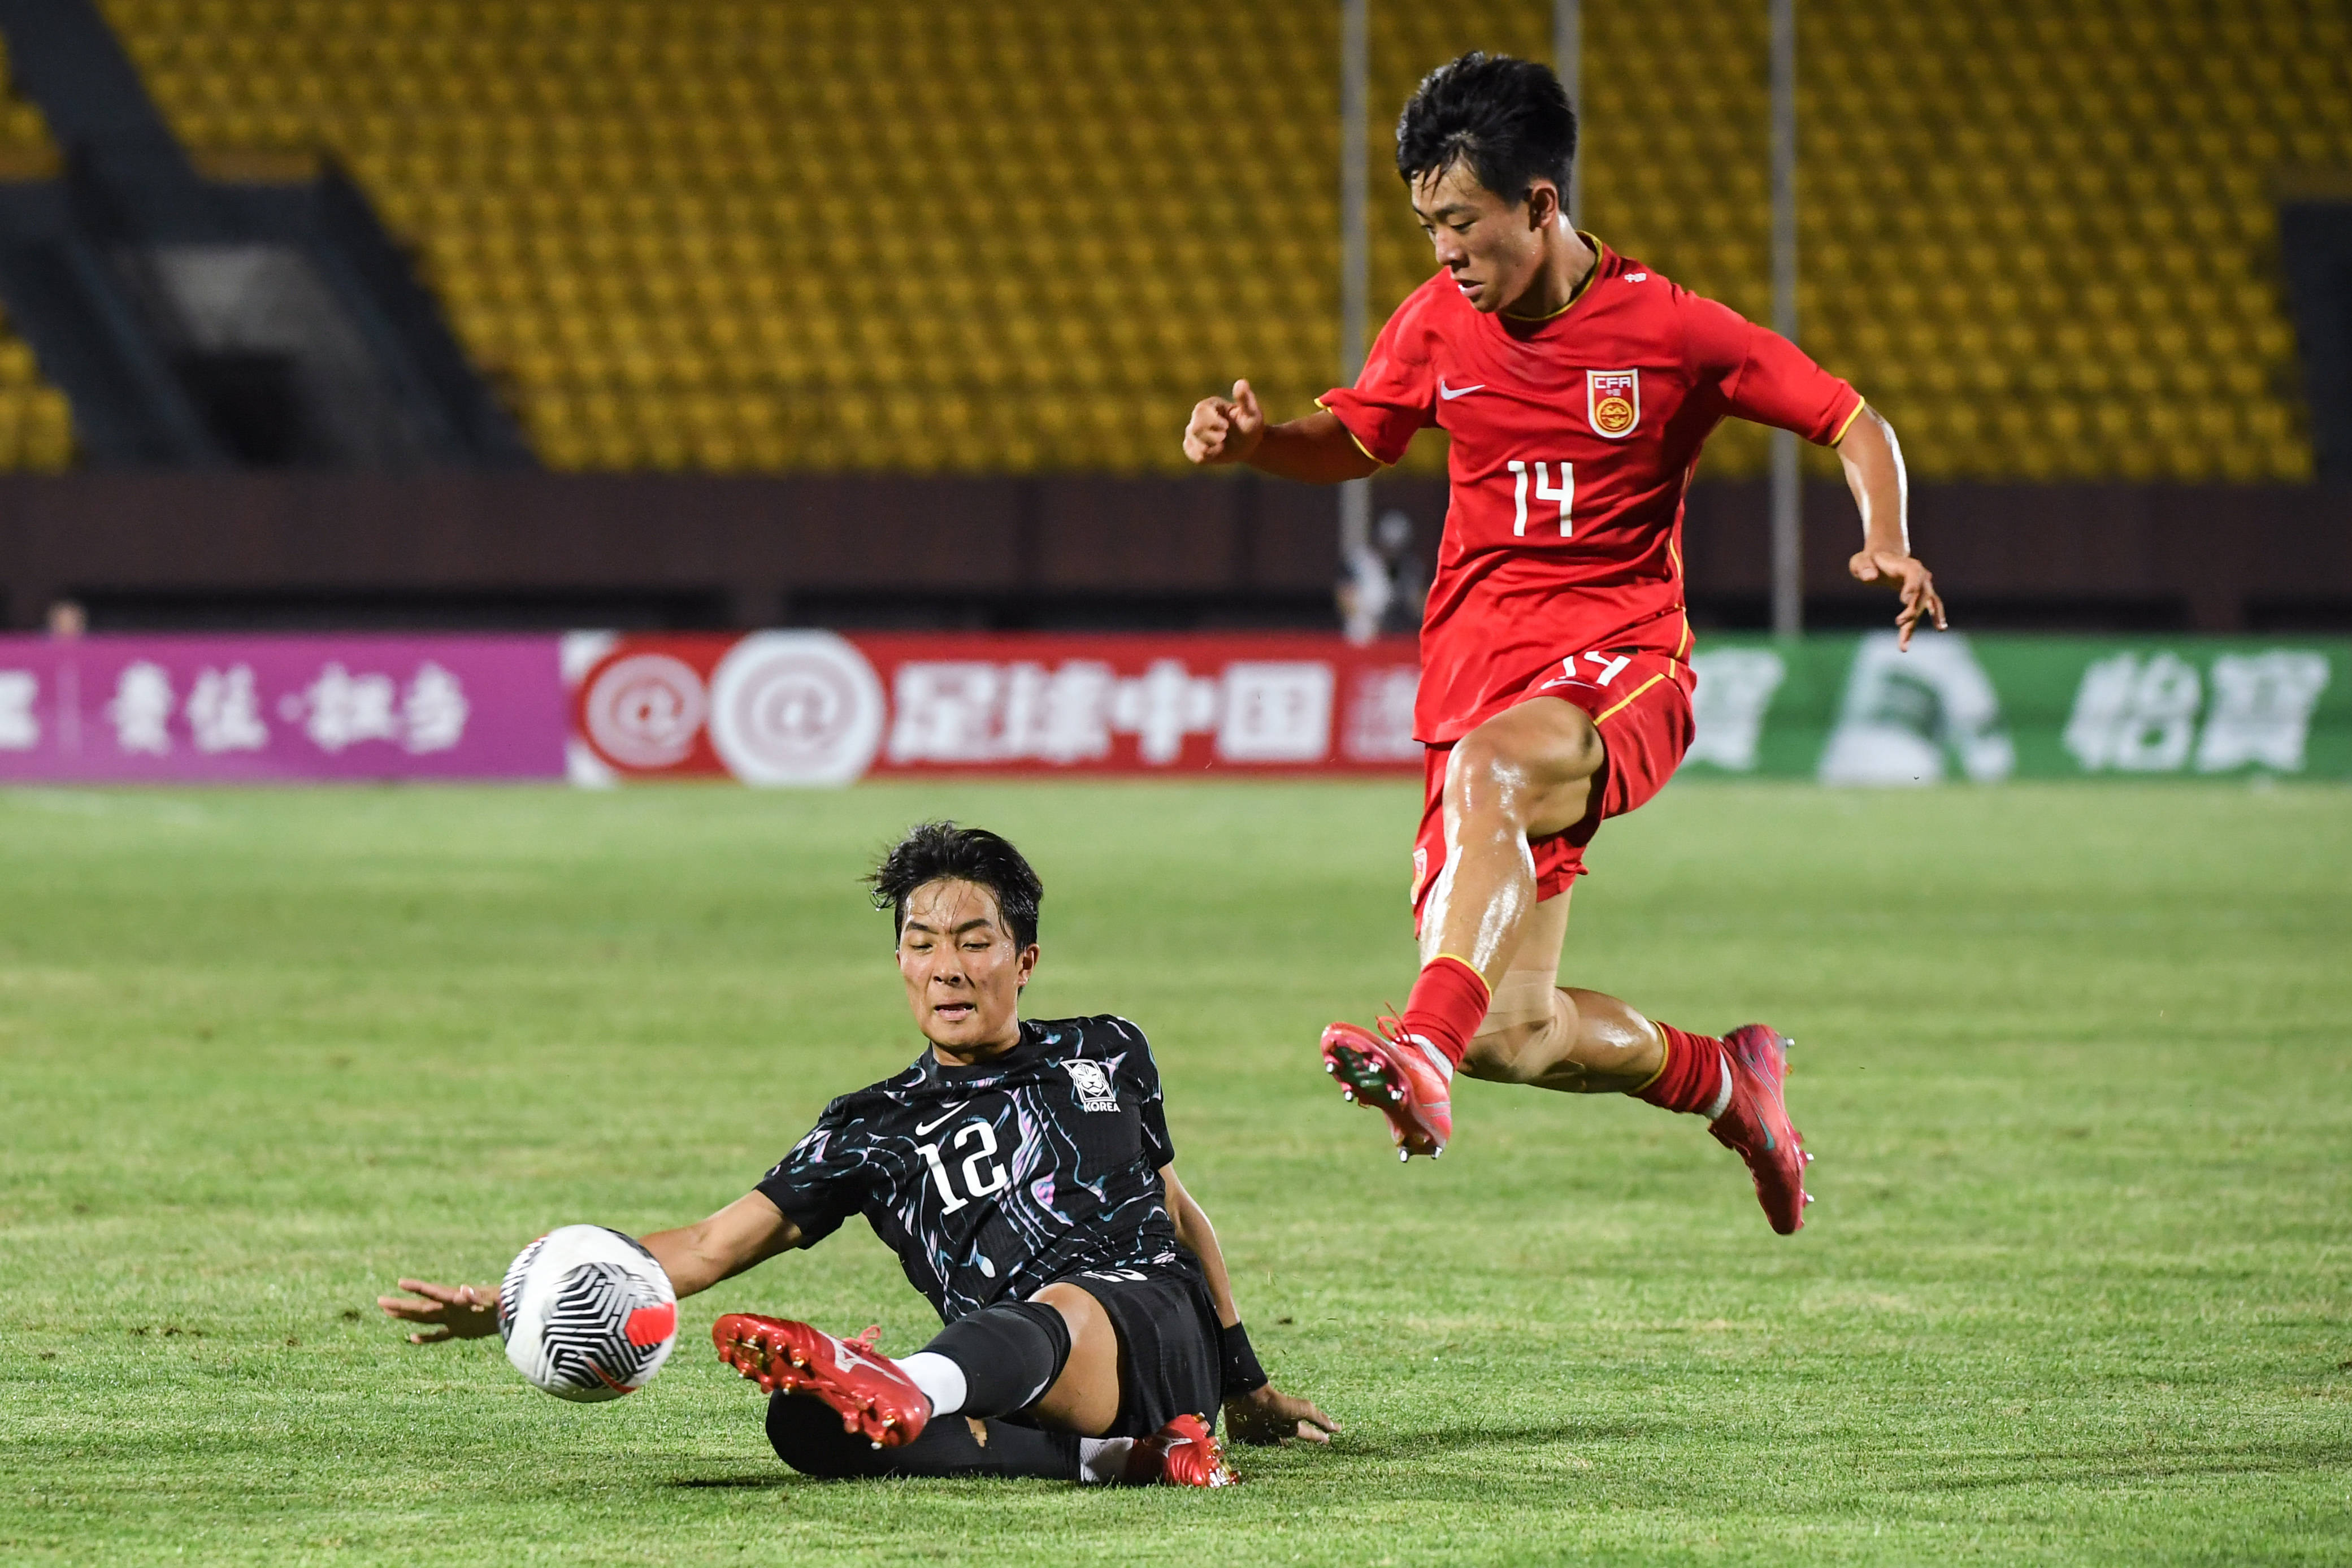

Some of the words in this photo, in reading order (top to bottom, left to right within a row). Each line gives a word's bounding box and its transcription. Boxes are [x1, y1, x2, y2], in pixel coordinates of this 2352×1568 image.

[1594, 376, 1631, 389] CFA
[1507, 460, 1574, 537] 14
[1083, 1101, 1121, 1113] KOREA
[914, 1122, 1008, 1215] 12
